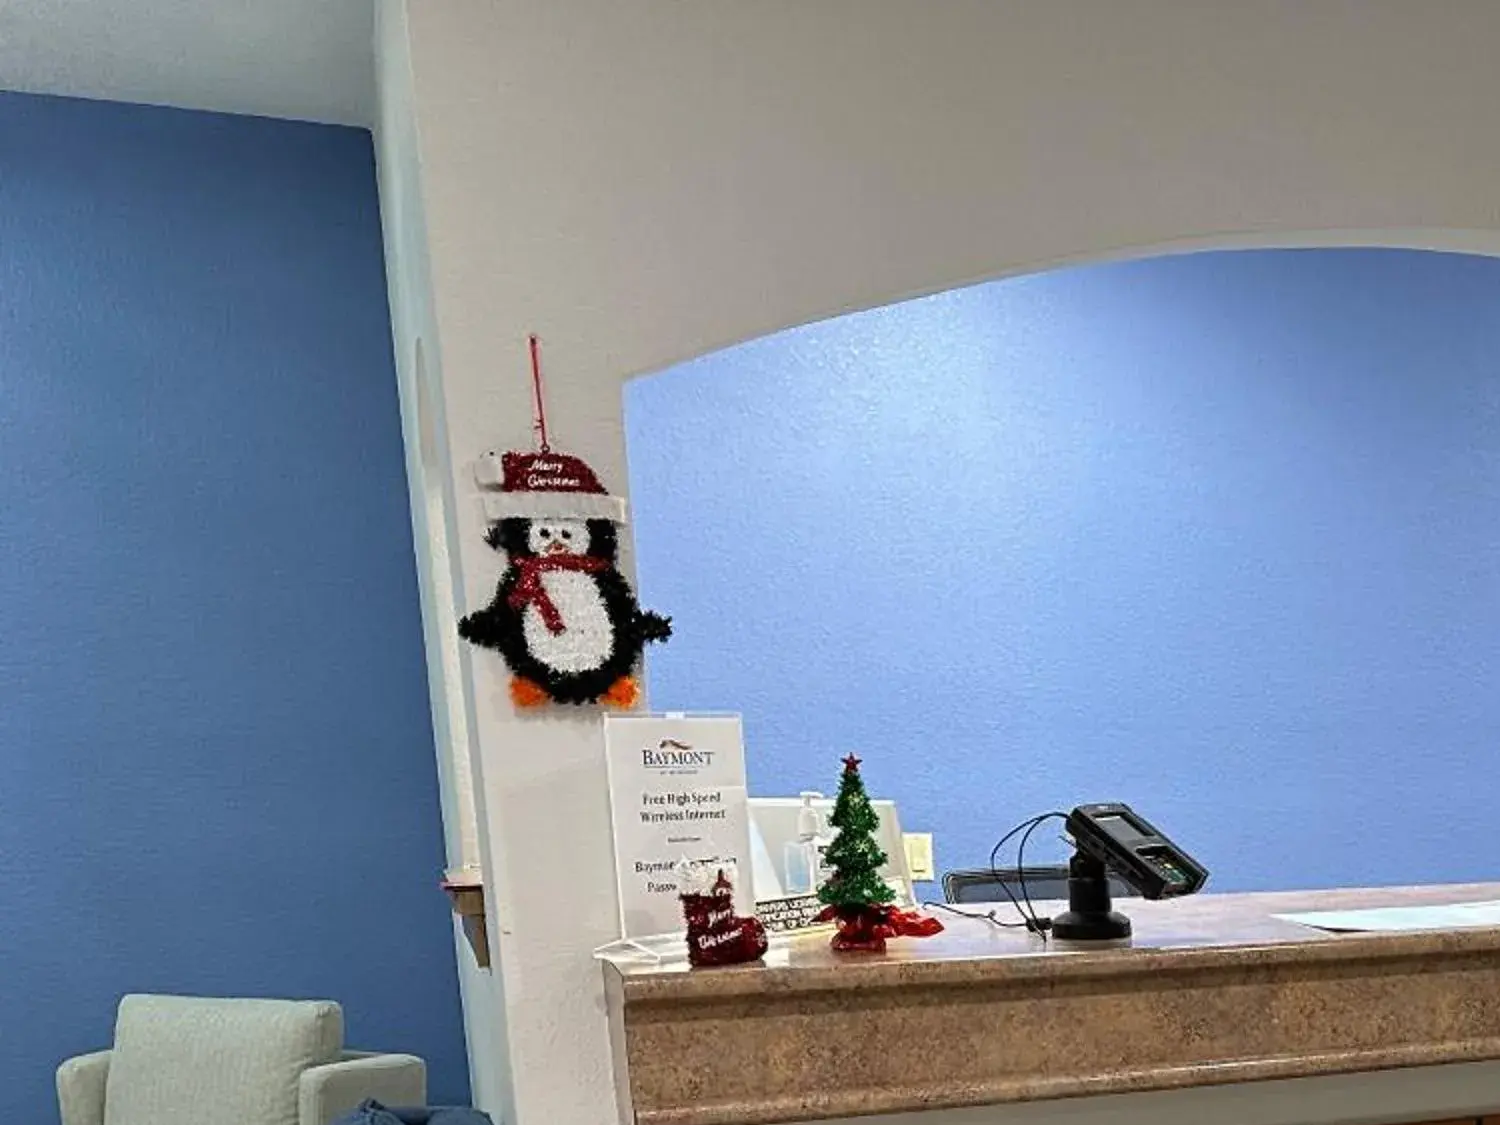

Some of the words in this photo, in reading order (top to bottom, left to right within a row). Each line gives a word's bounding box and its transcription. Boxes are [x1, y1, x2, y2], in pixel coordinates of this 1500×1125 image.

[641, 749, 716, 766] BAYMONT
[642, 793, 666, 806] Free
[667, 793, 691, 806] High
[692, 791, 722, 805] Speed
[640, 810, 684, 823] Wireless
[685, 808, 726, 821] Internet
